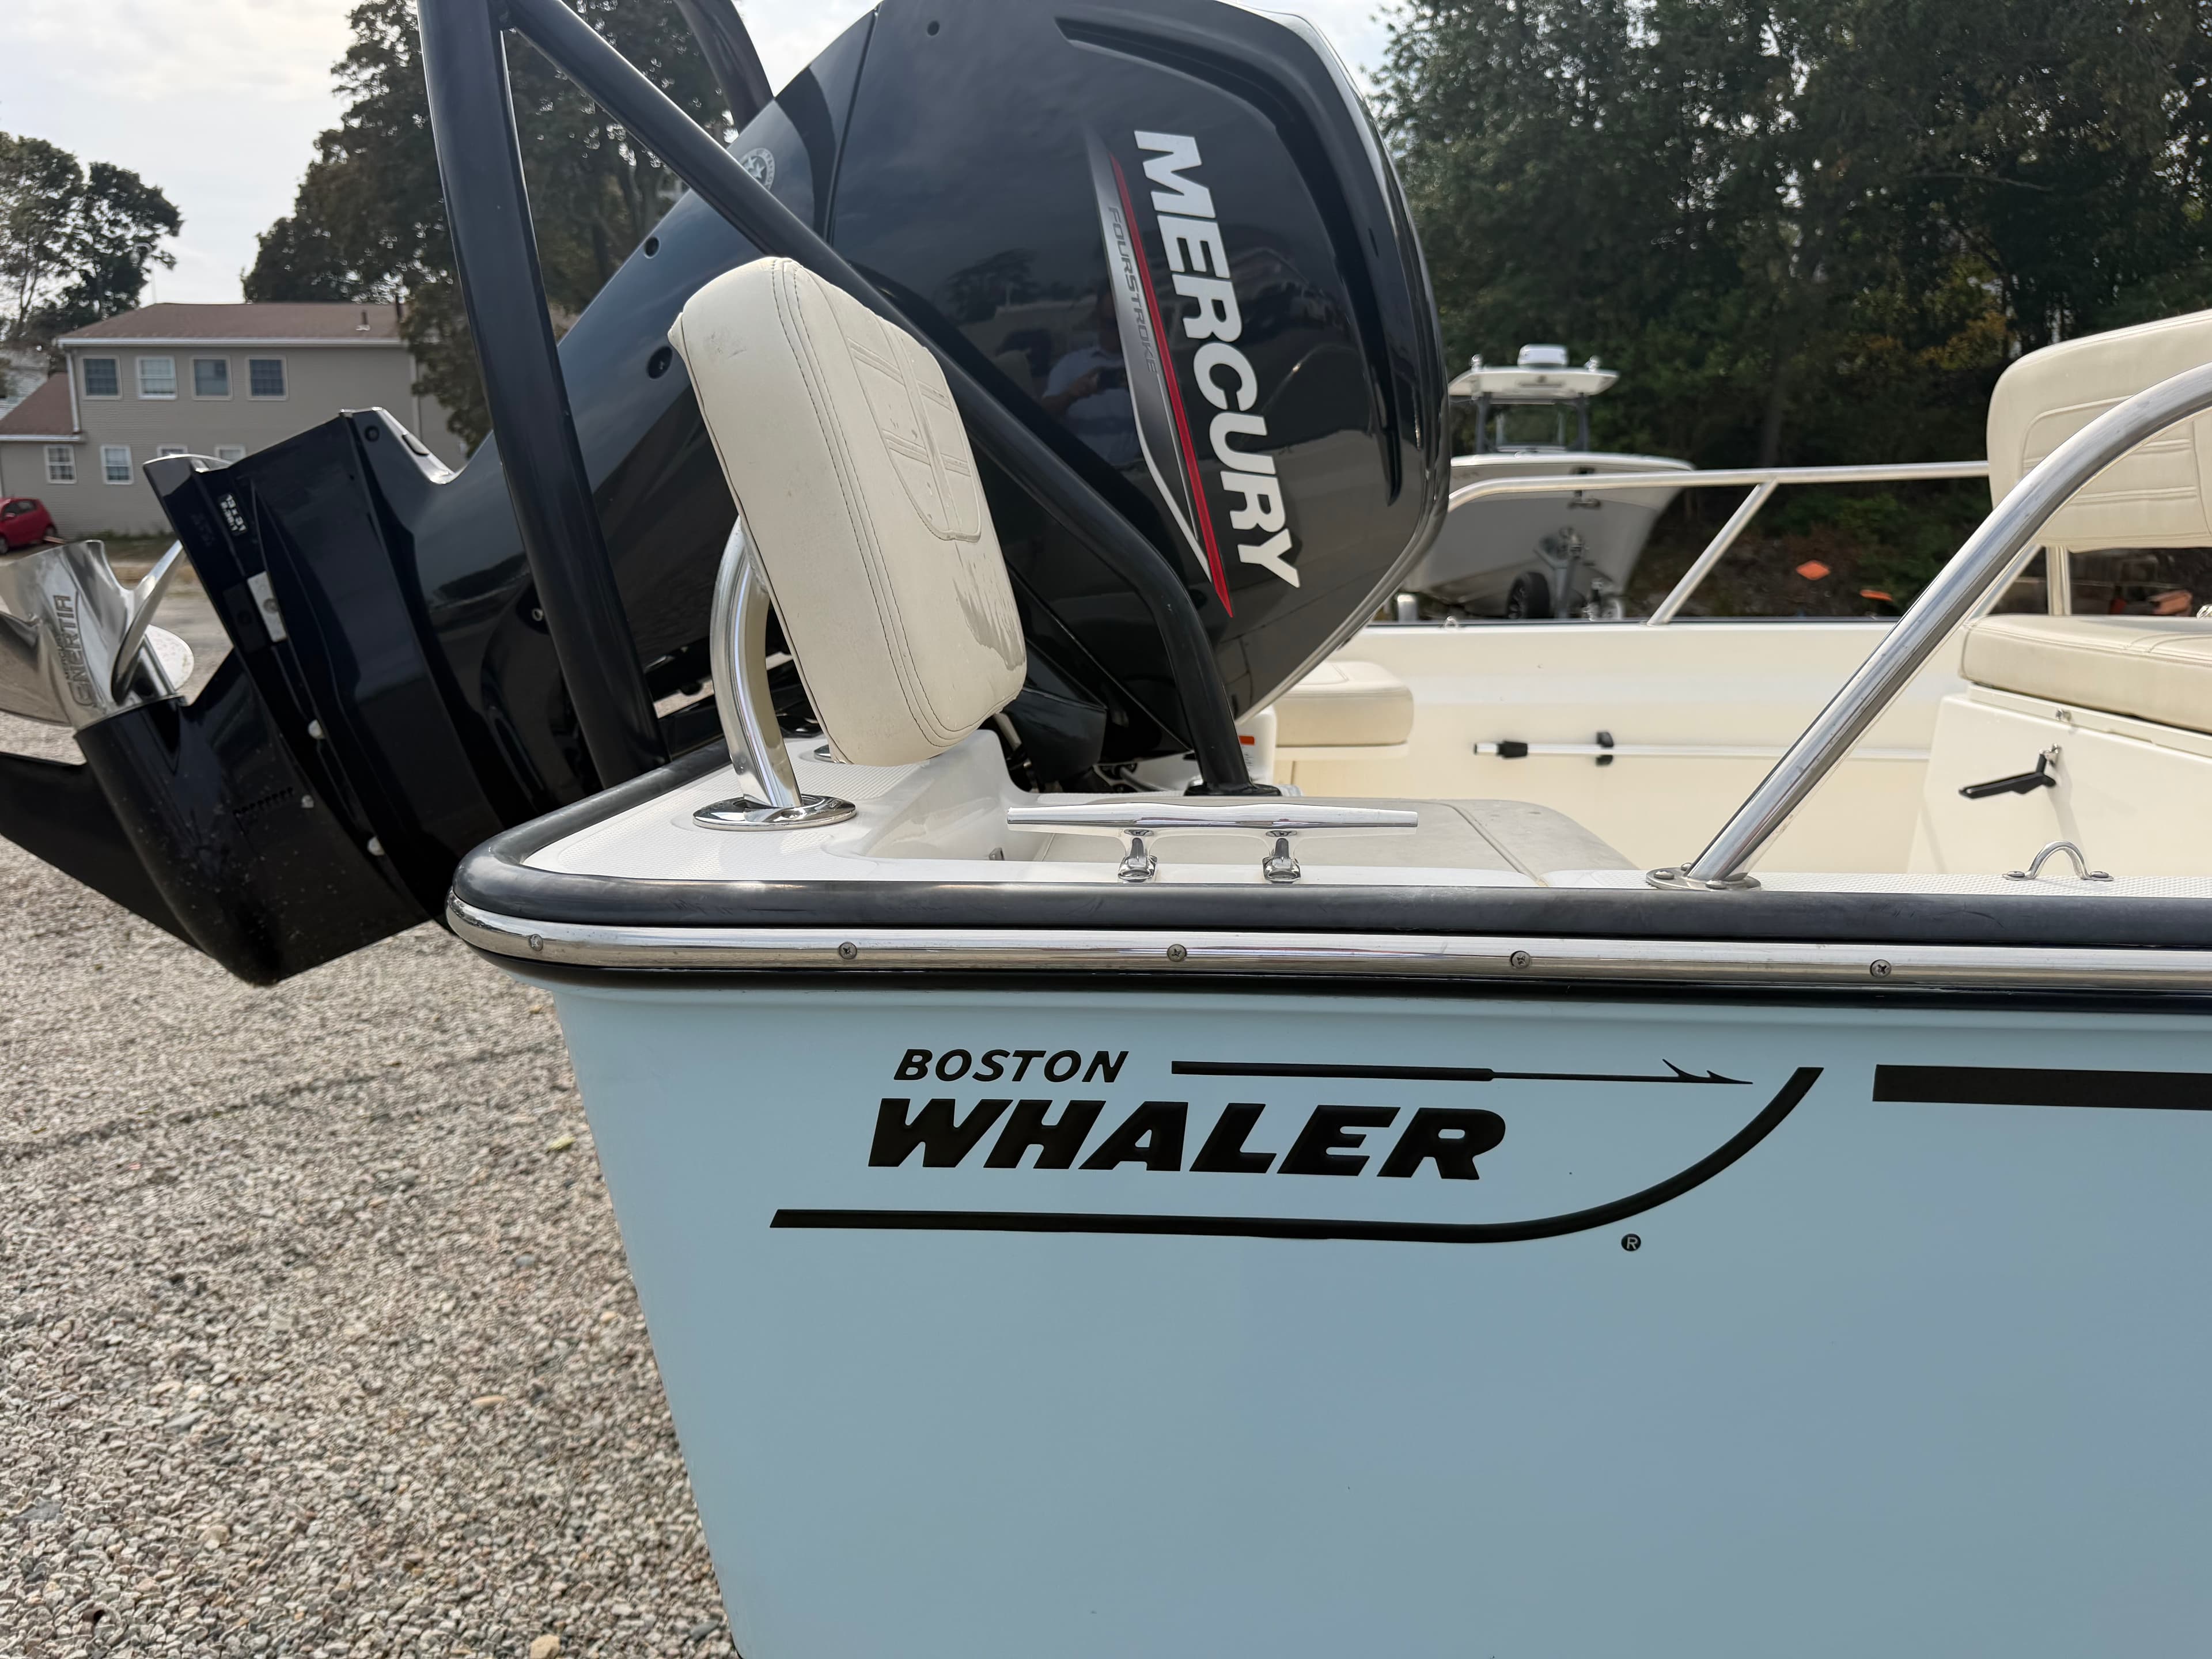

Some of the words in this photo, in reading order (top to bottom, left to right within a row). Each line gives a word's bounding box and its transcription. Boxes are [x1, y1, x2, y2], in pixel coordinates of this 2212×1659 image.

[1108, 207, 1157, 373] FOURSTROKE
[1134, 130, 1300, 588] MERCURY
[53, 594, 97, 707] ENERTIA
[893, 1048, 1130, 1083] BOSTON
[868, 1098, 1506, 1180] WHALER
